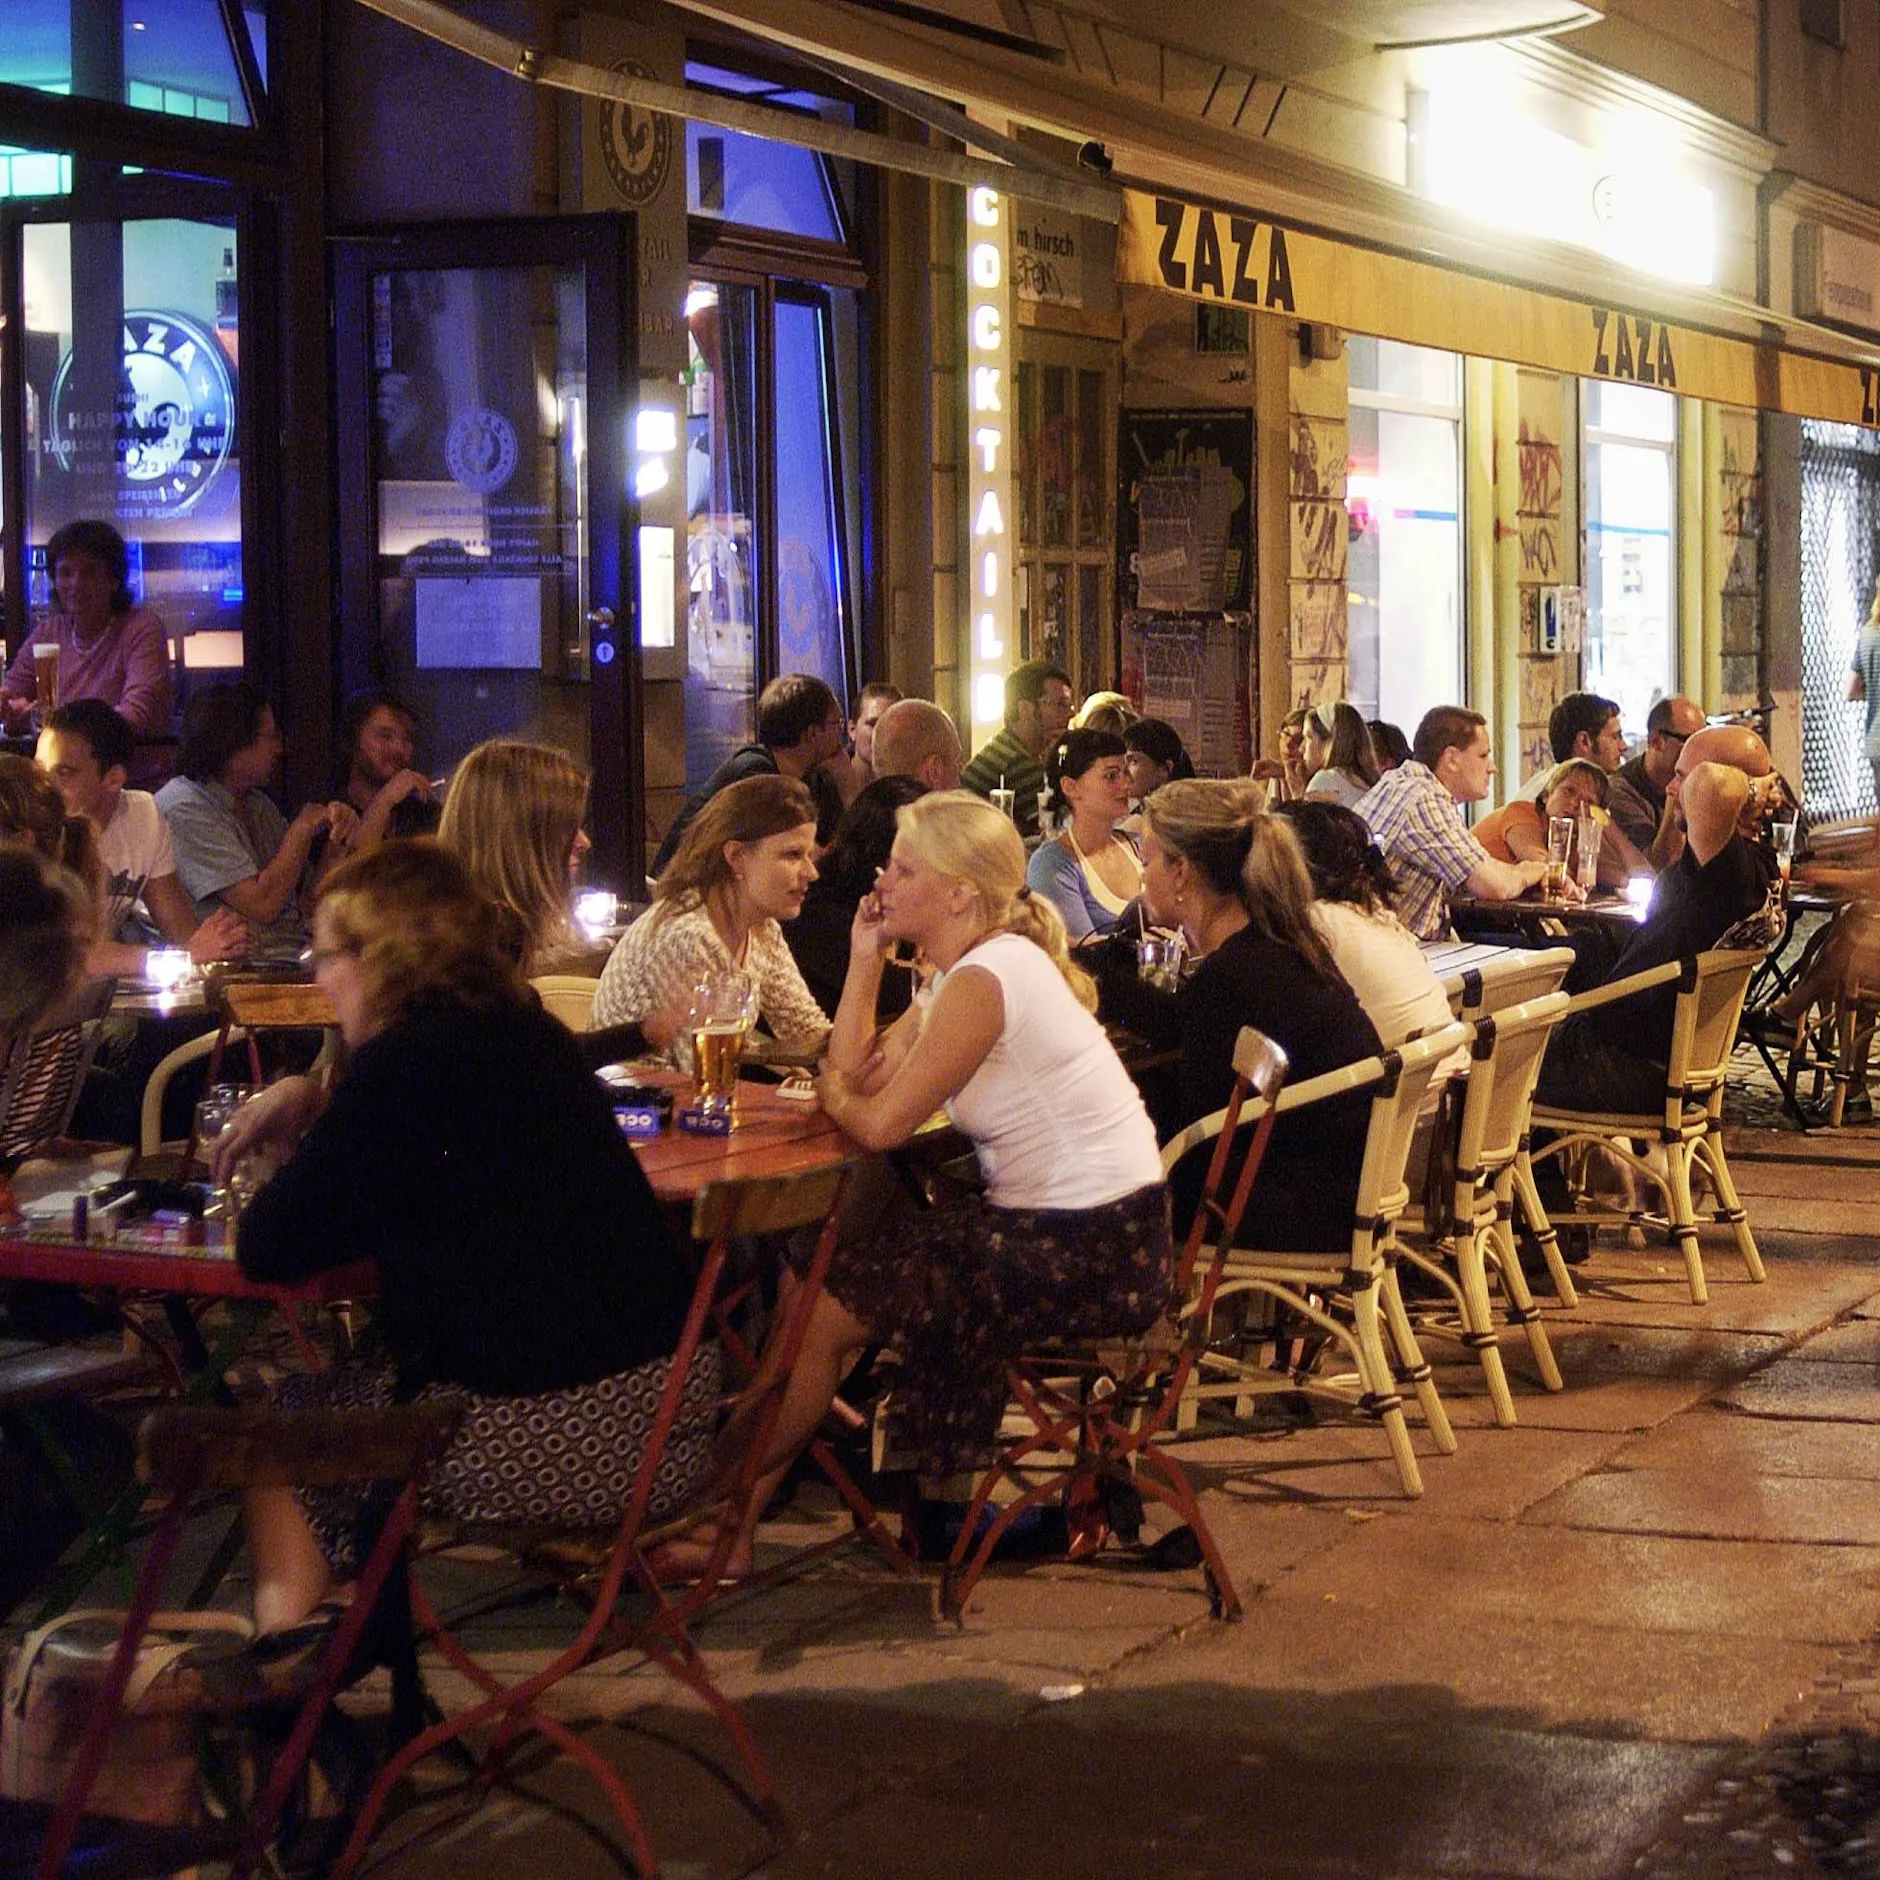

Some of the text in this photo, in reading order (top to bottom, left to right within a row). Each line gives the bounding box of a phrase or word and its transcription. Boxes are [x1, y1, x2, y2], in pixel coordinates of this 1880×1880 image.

[1156, 199, 1296, 312] ZAZA
[1592, 309, 1676, 388] ZAZA
[68, 411, 201, 430] HAPPY HOUR
[1859, 367, 1880, 428] Z
